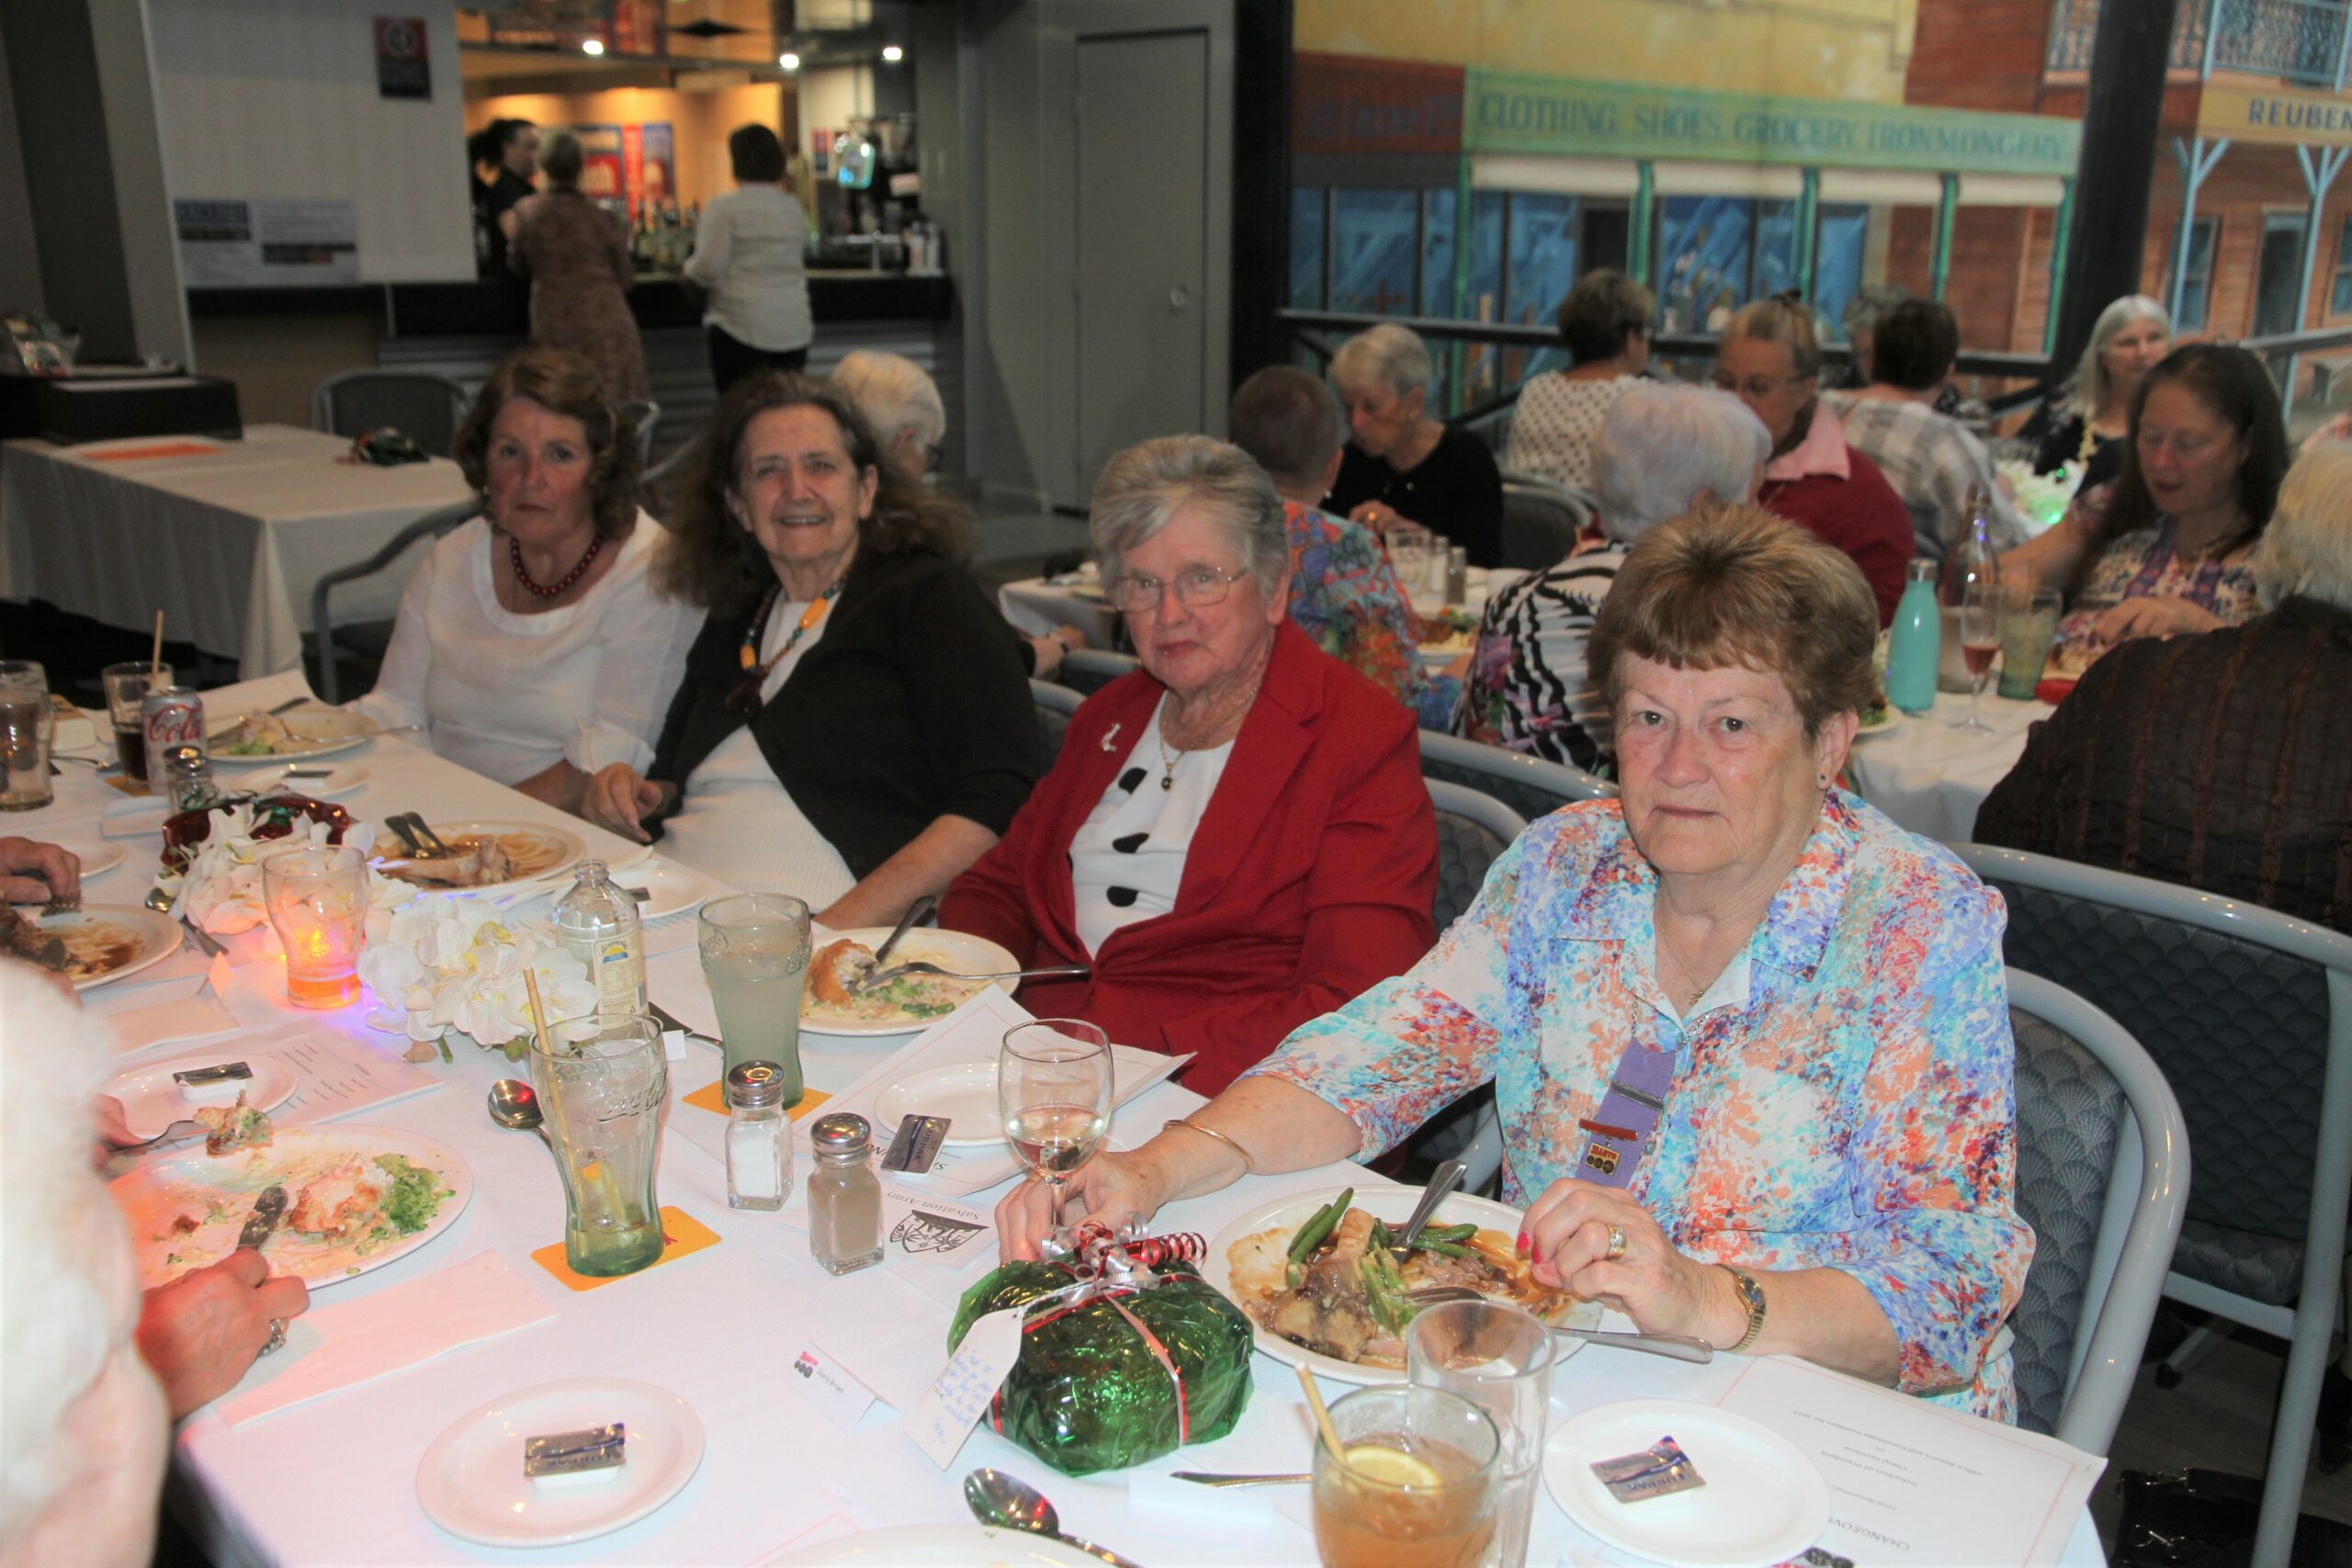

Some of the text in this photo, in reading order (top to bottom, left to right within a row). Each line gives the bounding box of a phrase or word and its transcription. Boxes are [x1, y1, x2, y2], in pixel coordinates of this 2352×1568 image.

[1478, 94, 1618, 135] CLOTHING
[1632, 102, 1723, 144] SHOES
[1733, 107, 1854, 151] GROCERY
[887, 1191, 981, 1221] Salvation Army
